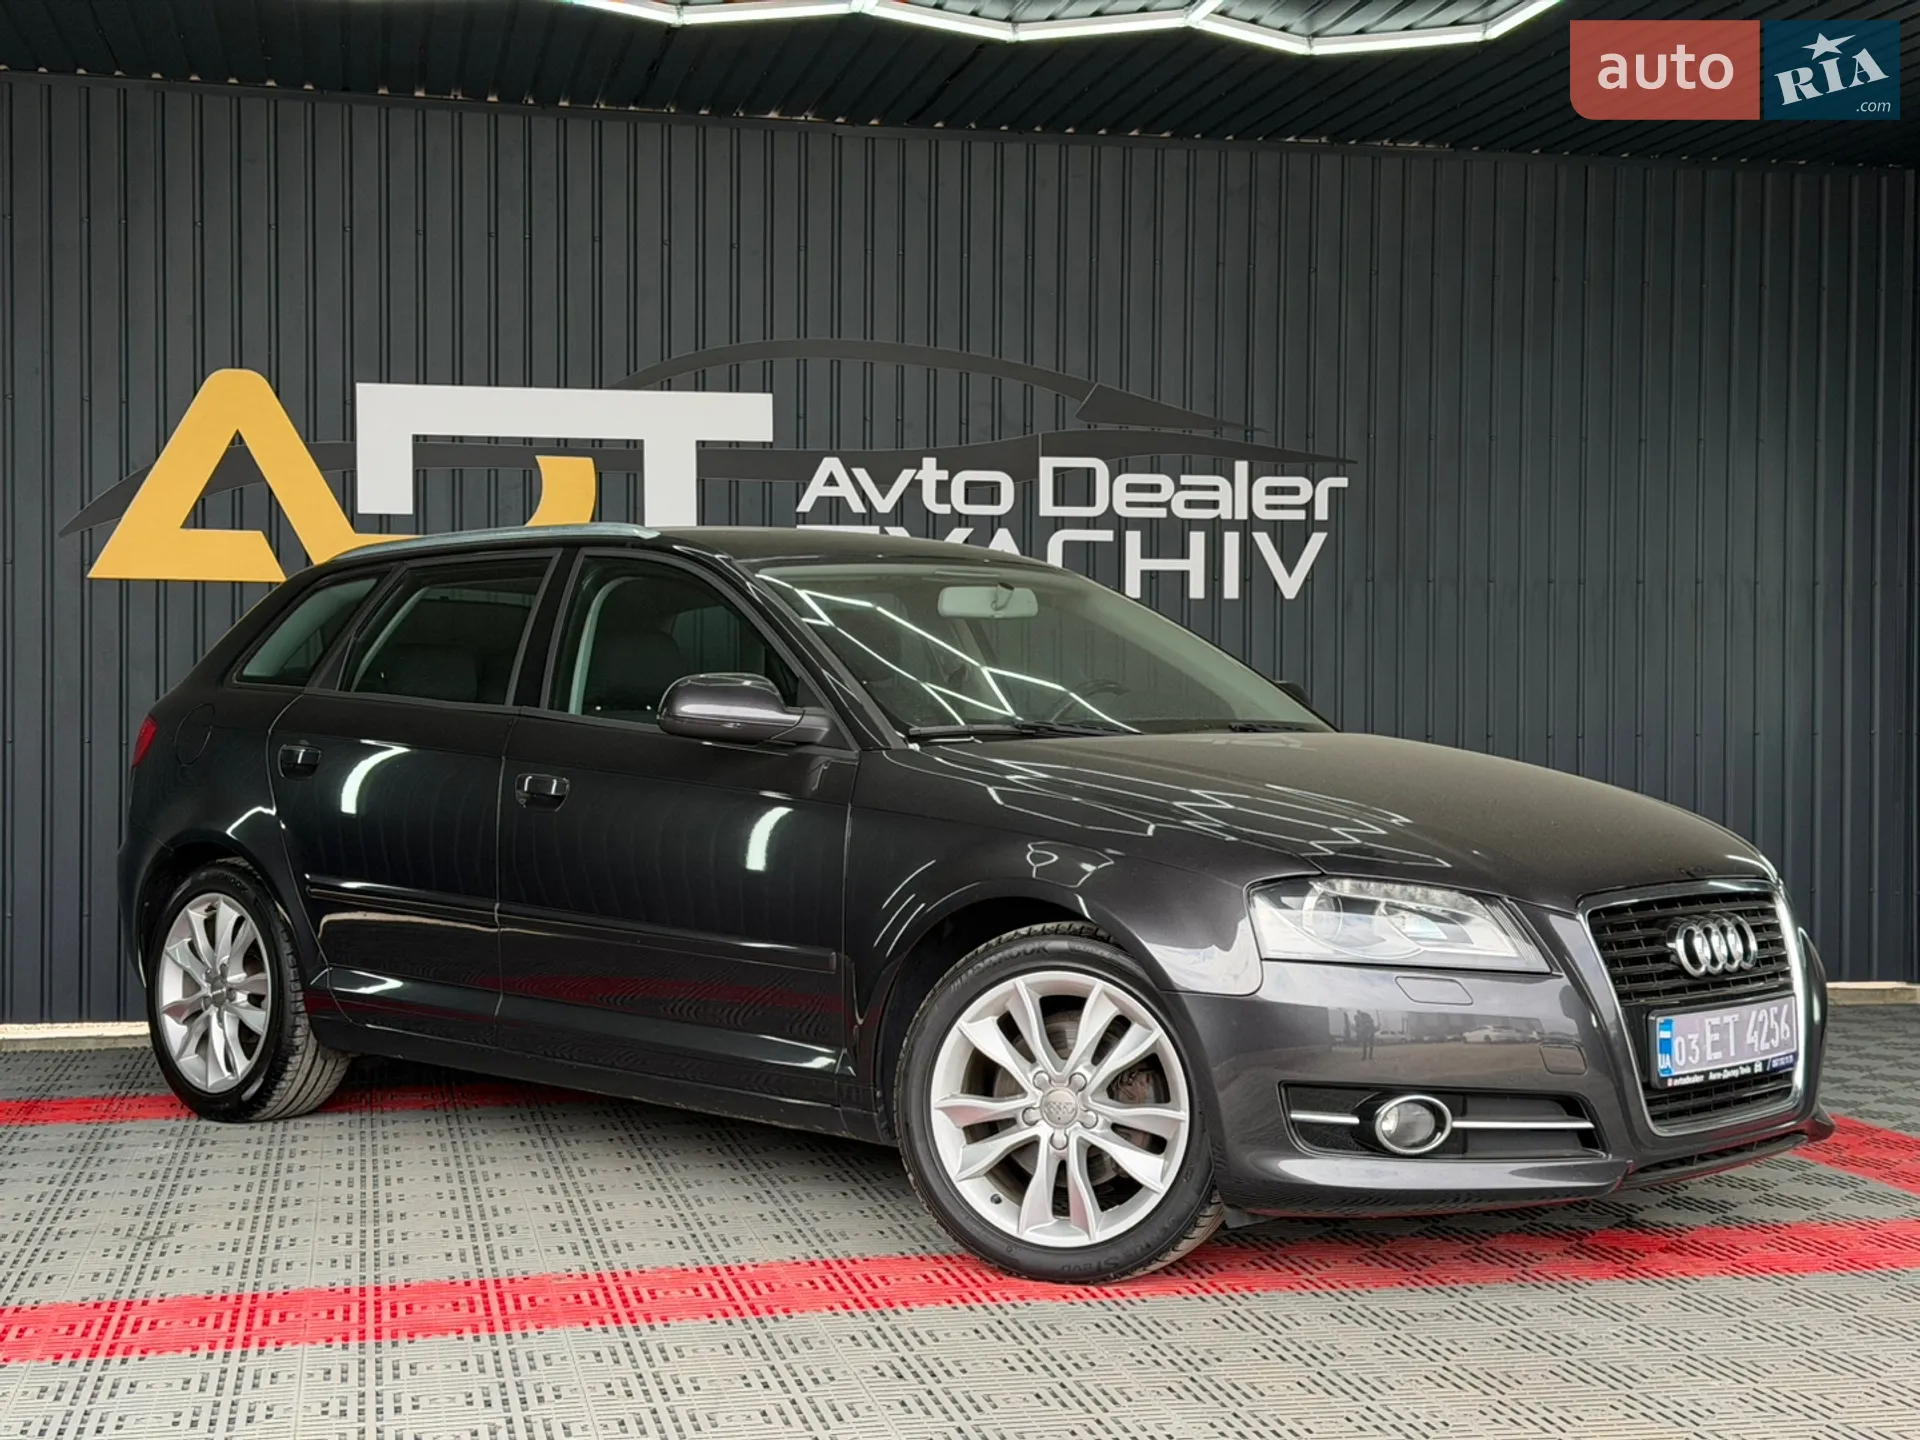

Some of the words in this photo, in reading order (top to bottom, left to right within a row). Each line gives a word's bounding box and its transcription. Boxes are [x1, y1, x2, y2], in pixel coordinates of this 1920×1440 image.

[795, 456, 1016, 516] Avto
[1038, 456, 1349, 521] Dealer
[1659, 1053, 1672, 1070] UA
[1704, 1013, 1740, 1062] ET
[1745, 1003, 1791, 1053] 4256
